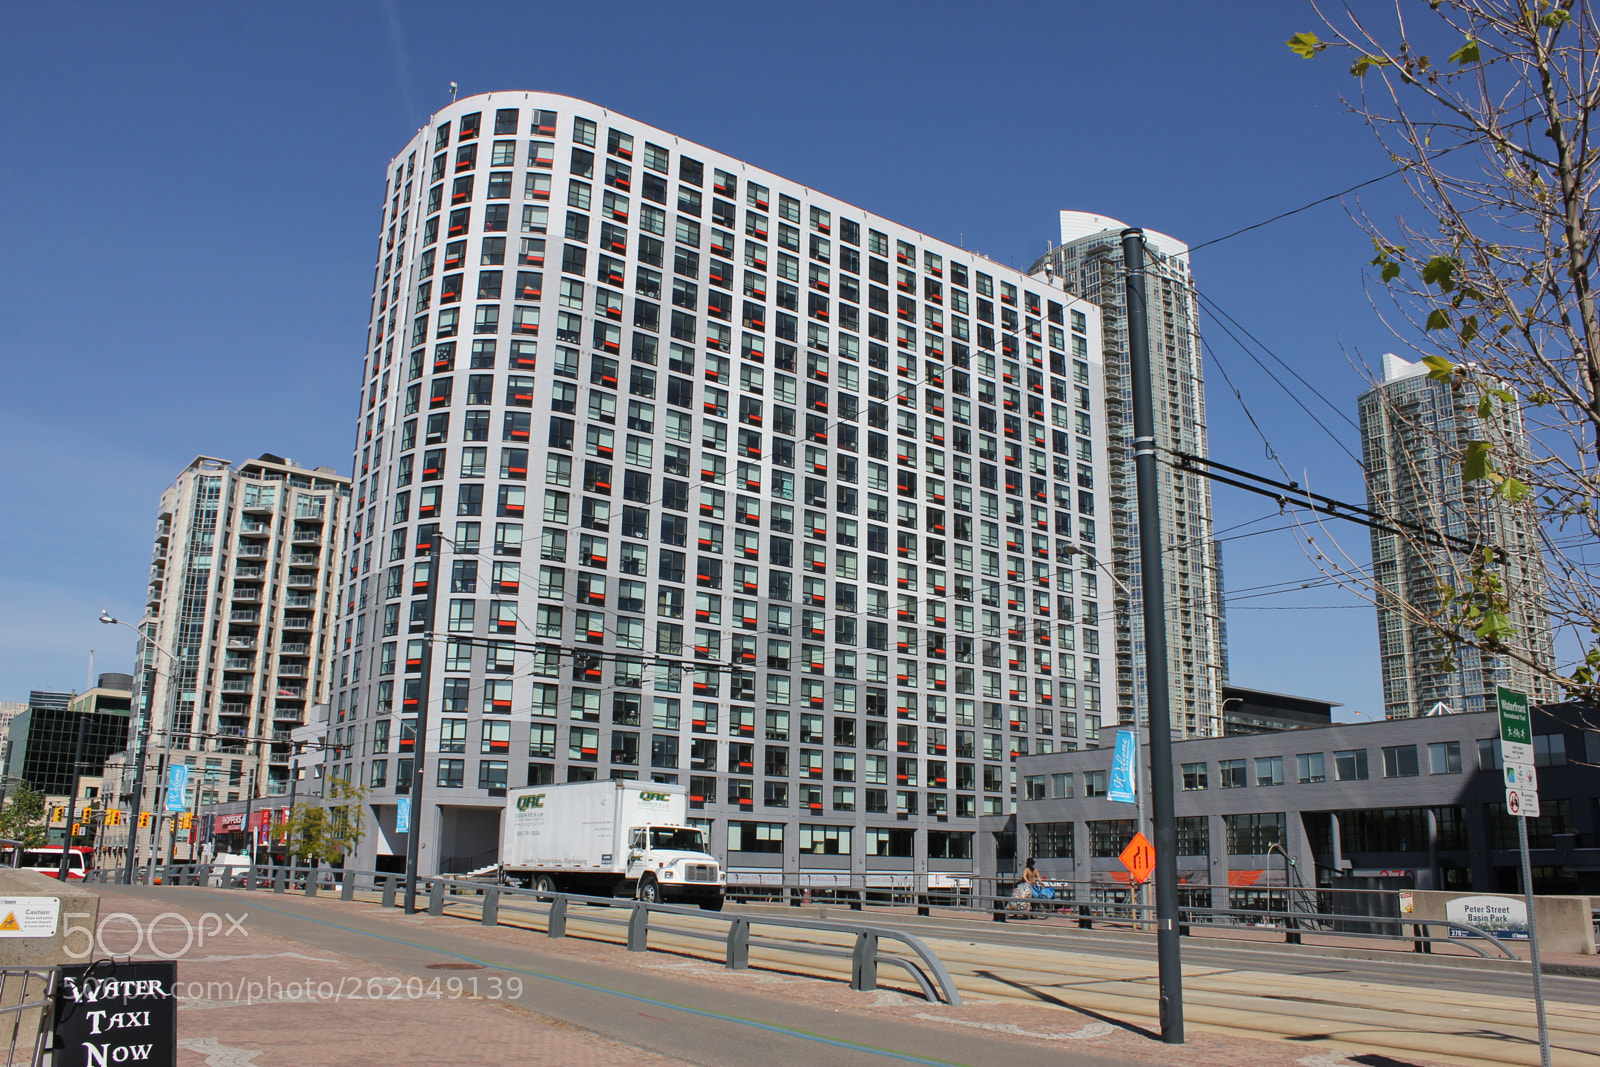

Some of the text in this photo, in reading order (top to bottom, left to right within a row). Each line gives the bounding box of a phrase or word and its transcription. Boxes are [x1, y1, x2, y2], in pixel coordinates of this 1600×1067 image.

[1464, 905, 1510, 913] Peter Street
[1468, 914, 1508, 922] Basin Park
